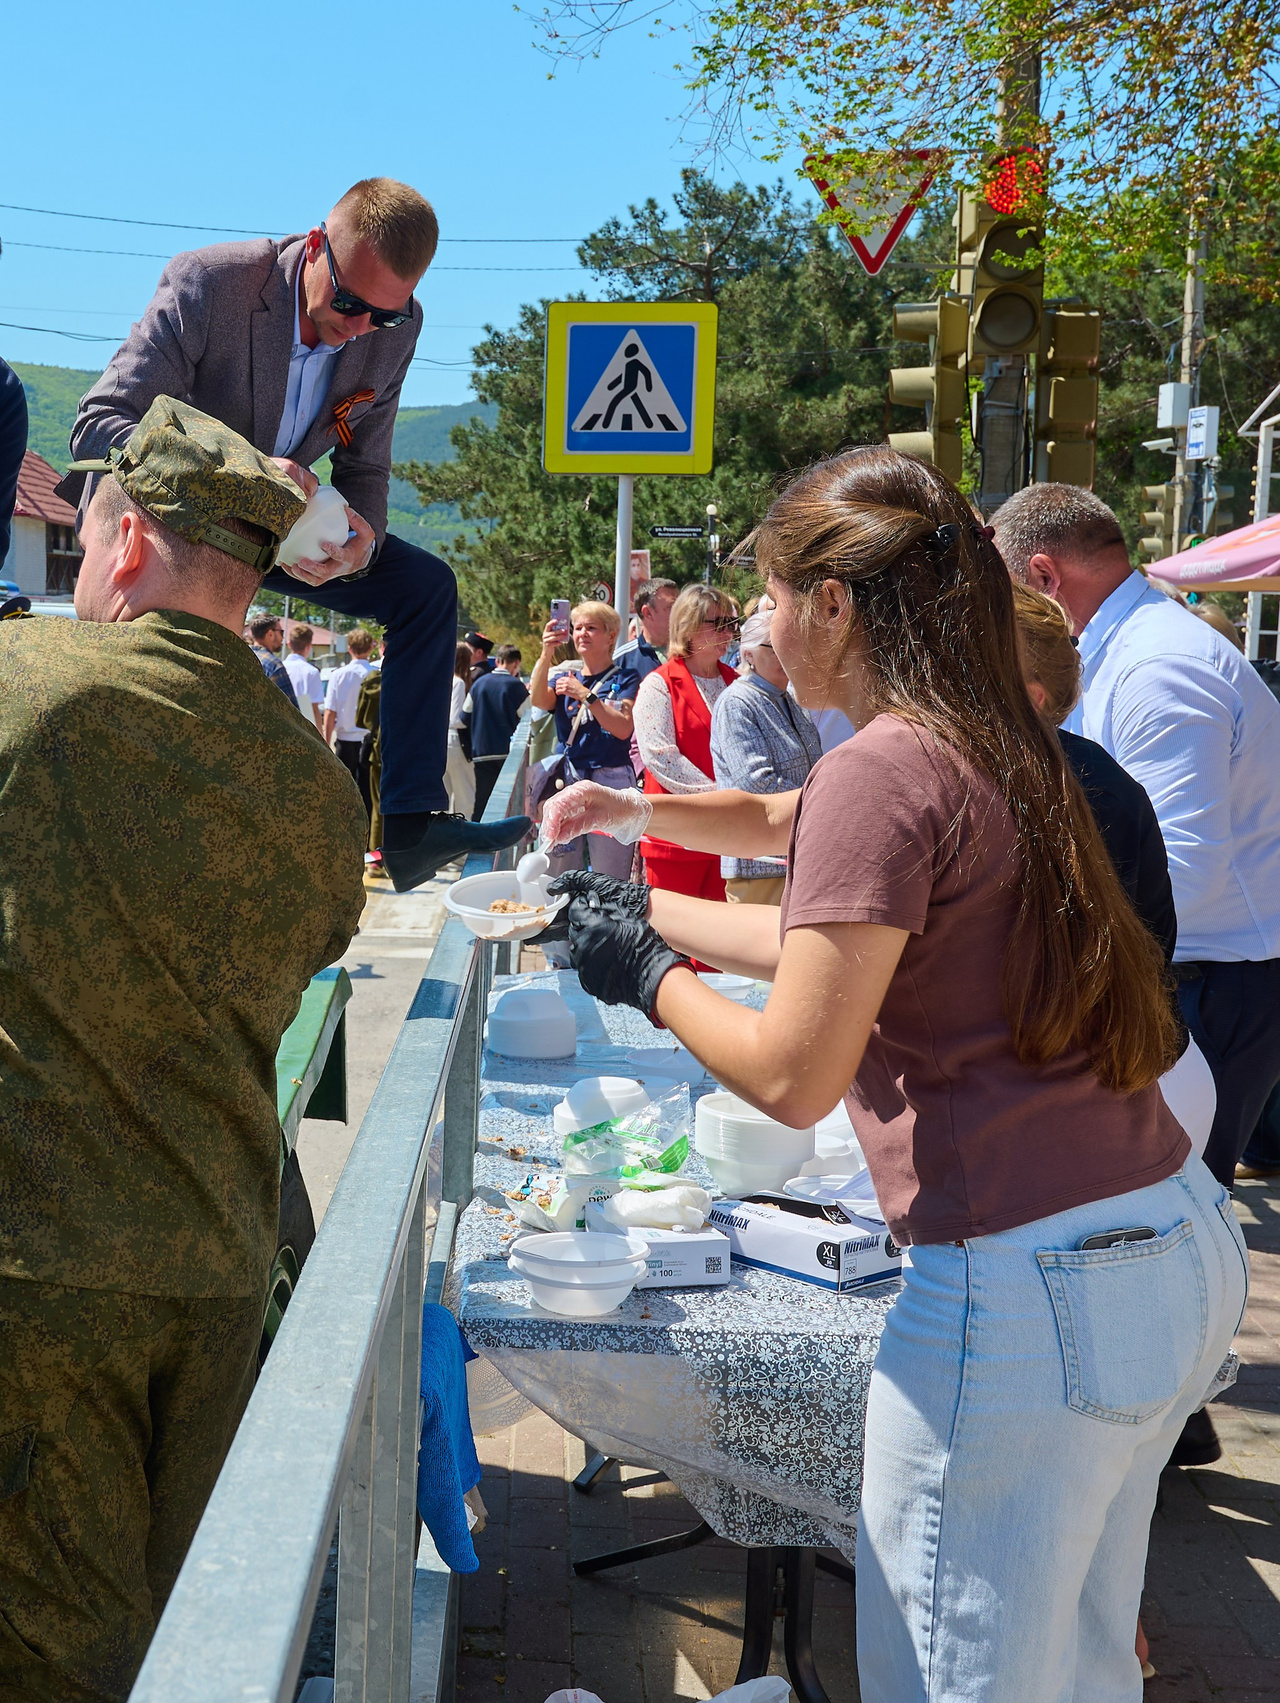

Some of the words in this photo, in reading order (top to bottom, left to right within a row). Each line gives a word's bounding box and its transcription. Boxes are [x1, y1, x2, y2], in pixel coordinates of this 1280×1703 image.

[708, 1208, 751, 1231] NitriMAX
[823, 1244, 837, 1259] XL
[843, 1234, 881, 1255] NitriMAX
[659, 1269, 673, 1277] 100
[845, 1265, 857, 1276] 788
